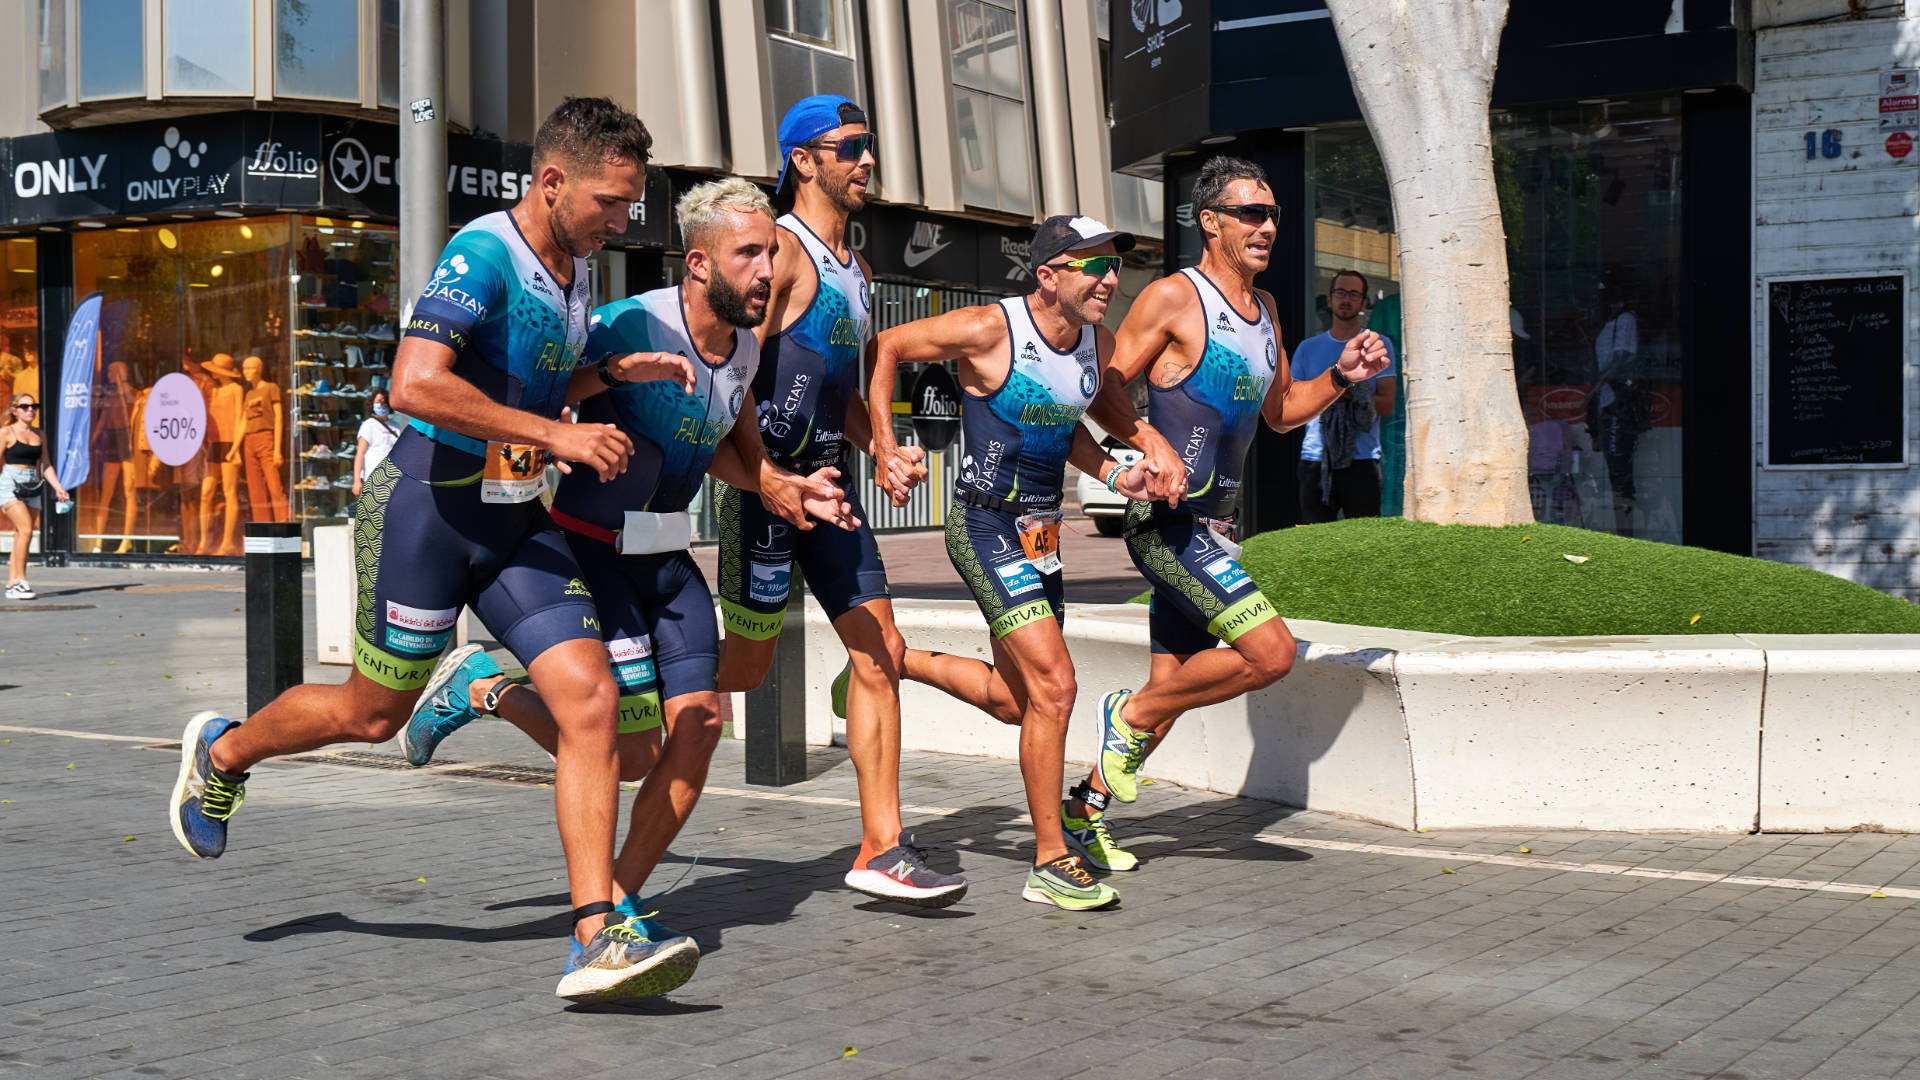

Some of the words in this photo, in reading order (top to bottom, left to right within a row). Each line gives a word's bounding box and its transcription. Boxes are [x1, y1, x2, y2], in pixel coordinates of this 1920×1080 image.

[1804, 129, 1842, 160] 16
[15, 154, 107, 198] ONLY
[127, 178, 181, 201] ONLY
[183, 173, 230, 197] PLAY
[912, 221, 944, 248] NIKE
[436, 285, 488, 321] ACTAYS
[781, 374, 808, 421] ACTAYS
[920, 386, 957, 416] ffolio
[153, 417, 197, 440] -50%
[1182, 425, 1205, 467] ACTAYS
[982, 440, 1001, 488] ACTAYS
